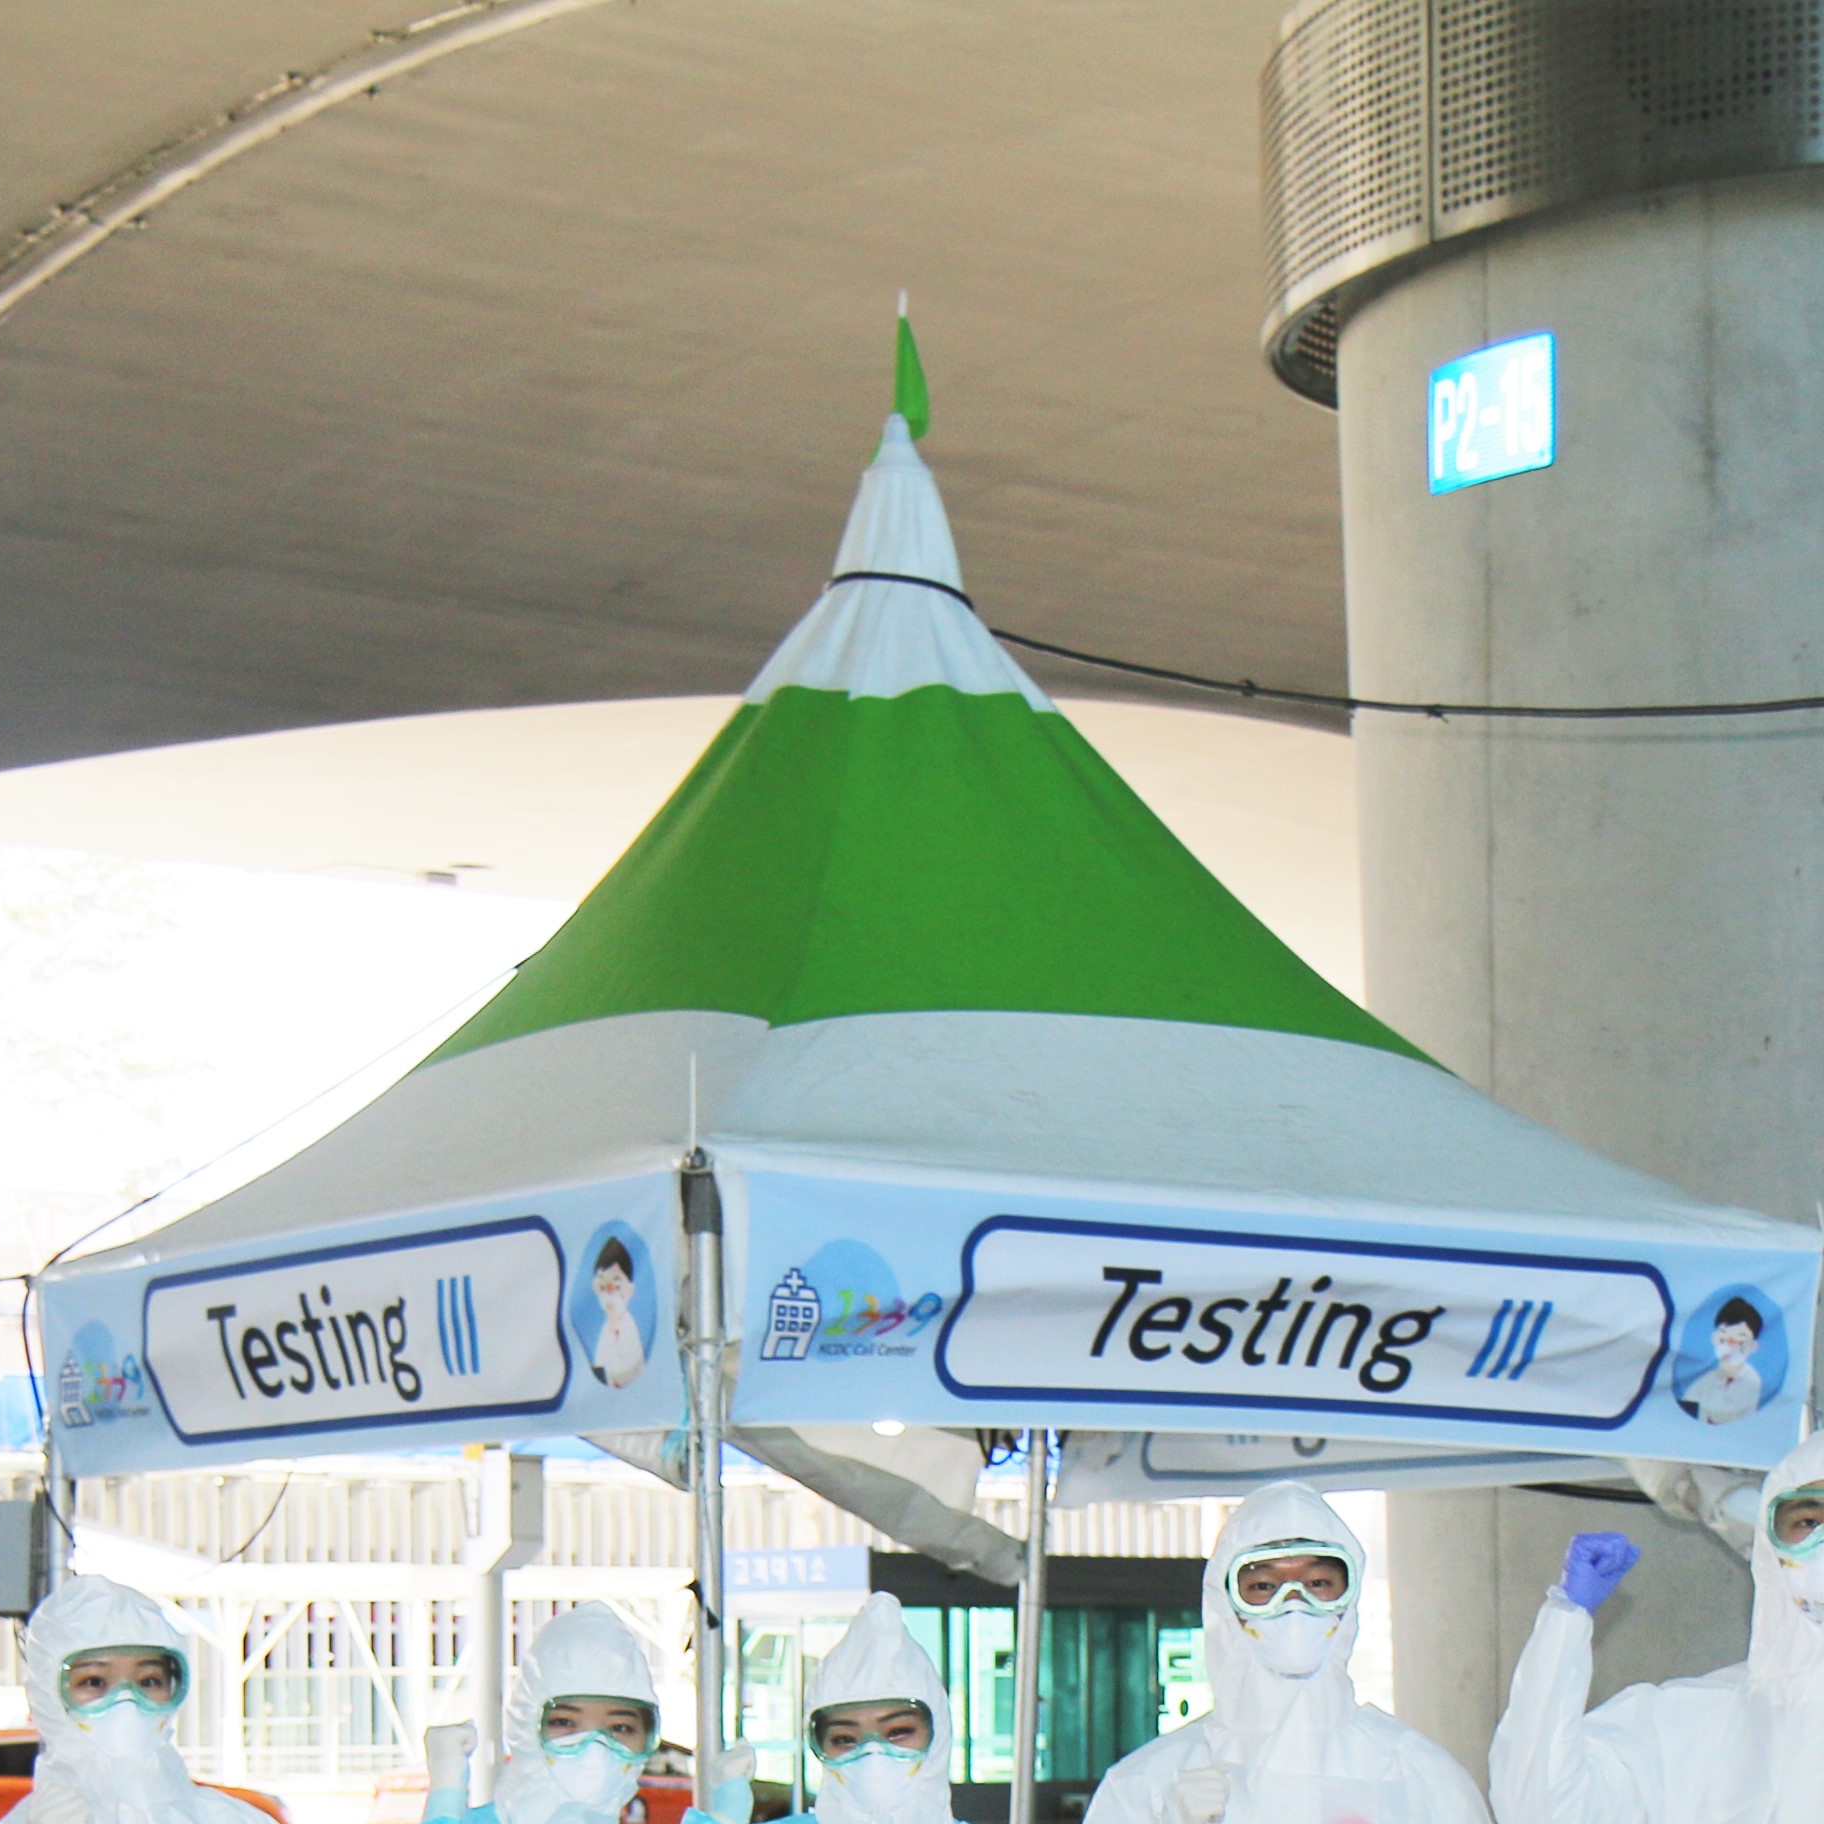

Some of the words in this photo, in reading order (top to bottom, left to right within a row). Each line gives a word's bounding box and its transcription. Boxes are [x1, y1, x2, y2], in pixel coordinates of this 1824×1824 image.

[1434, 352, 1547, 479] P2-15
[207, 1285, 422, 1402] Testing
[824, 1289, 944, 1338] 1339
[1090, 1266, 1445, 1393] Testing
